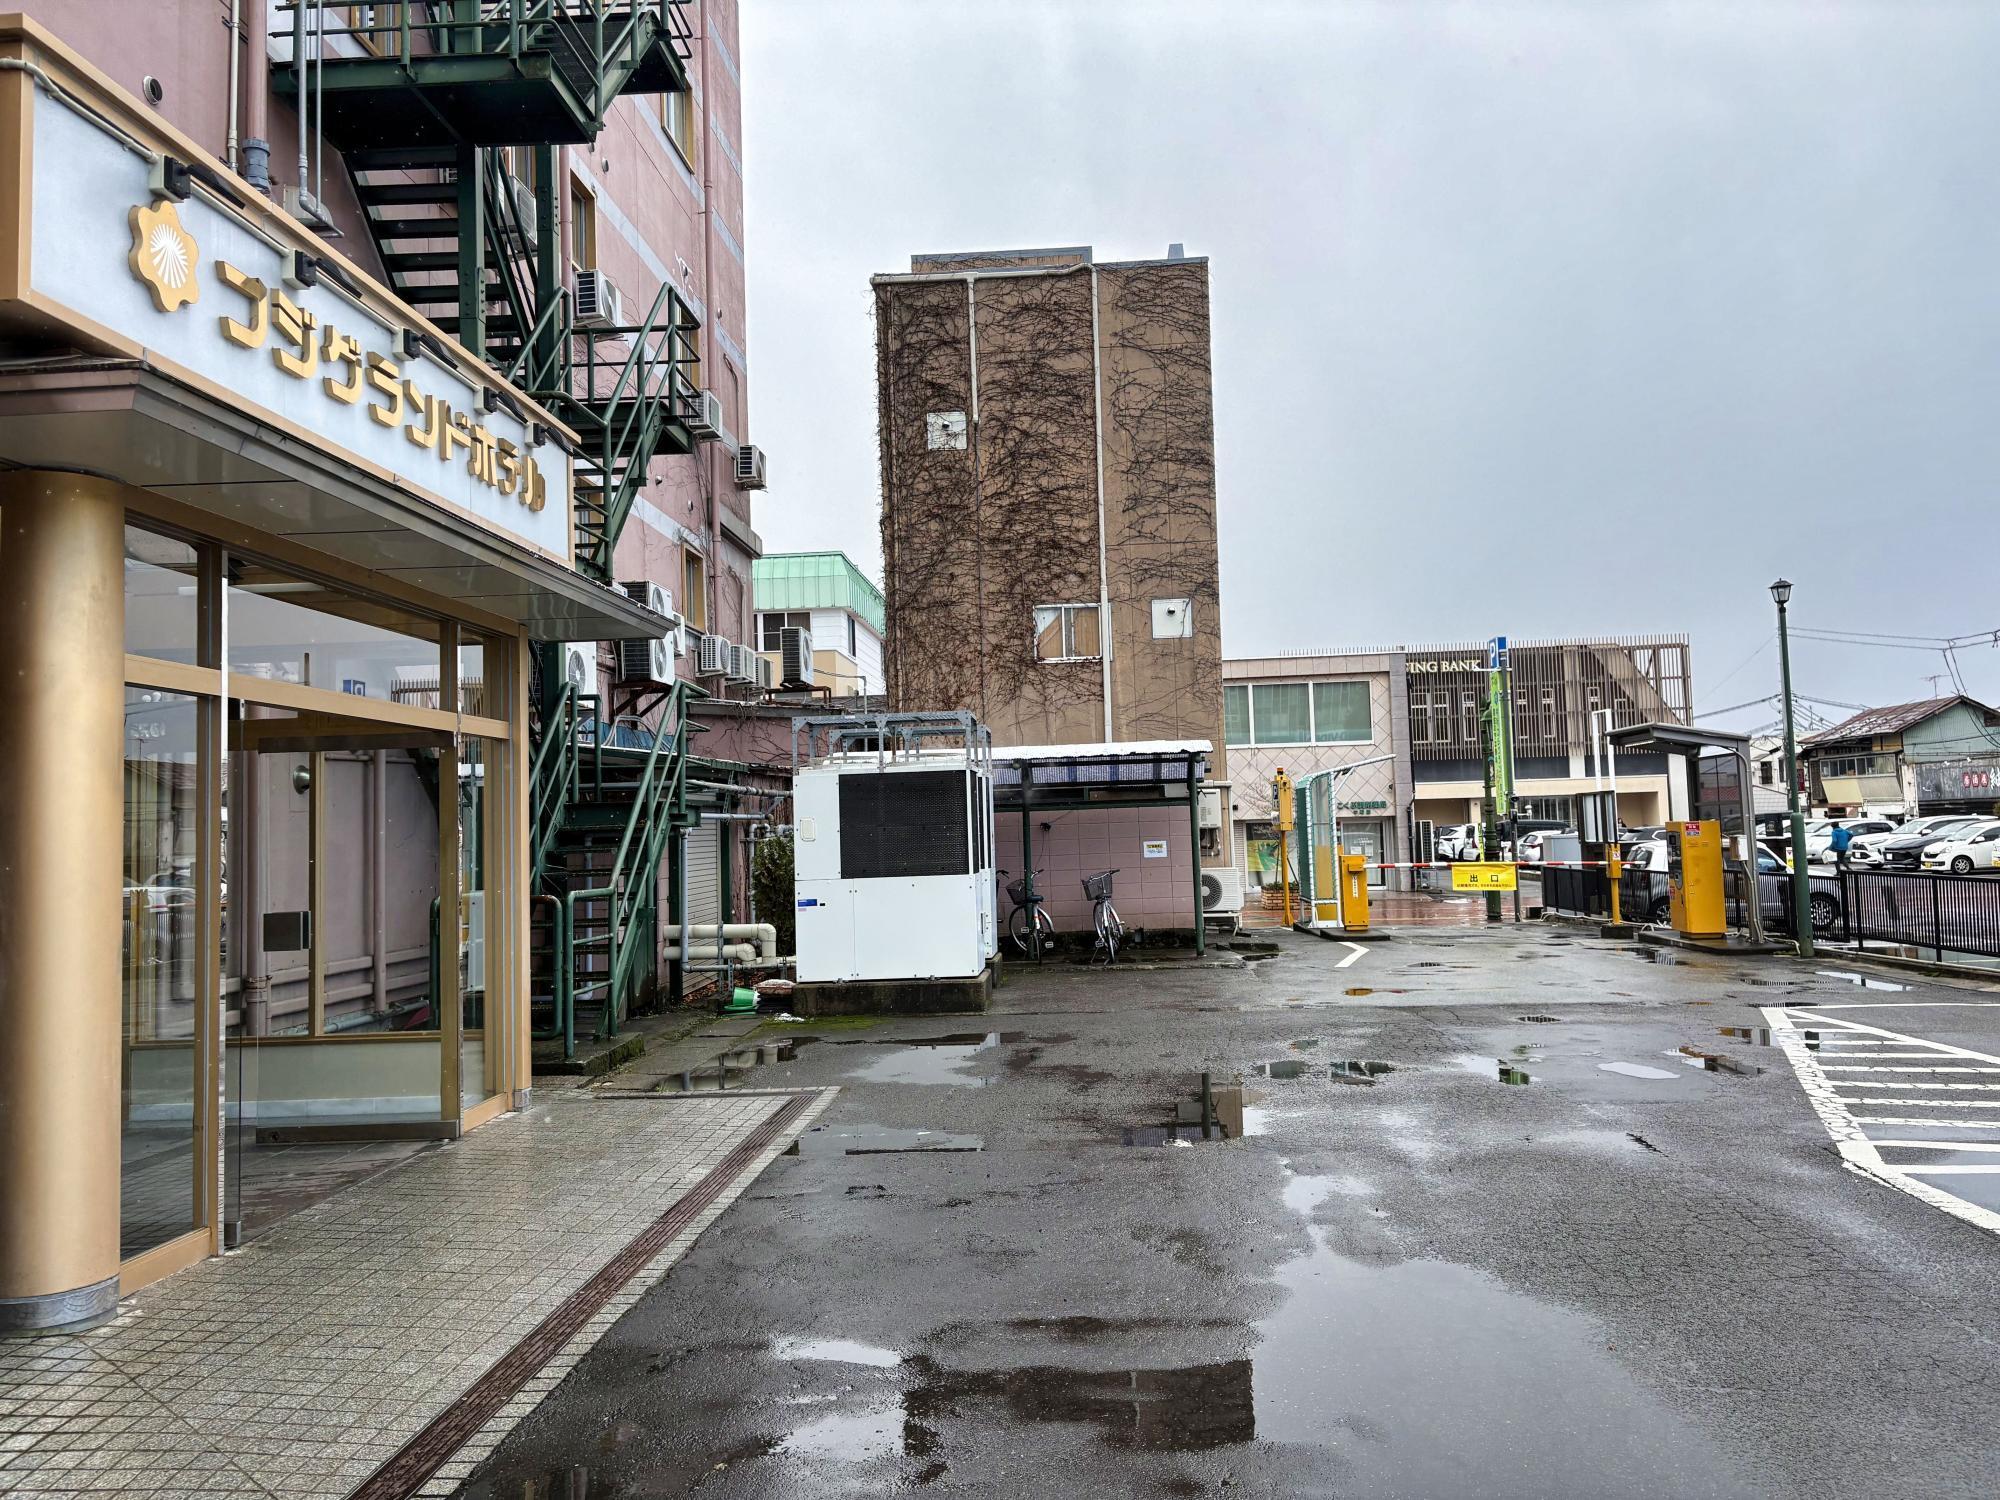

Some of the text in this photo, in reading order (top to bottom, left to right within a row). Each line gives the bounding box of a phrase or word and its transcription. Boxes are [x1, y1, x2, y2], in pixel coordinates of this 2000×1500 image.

[215, 260, 546, 512] フジグランドホテル
[1440, 660, 1481, 672] BANK
[1469, 874, 1499, 882] 出口
